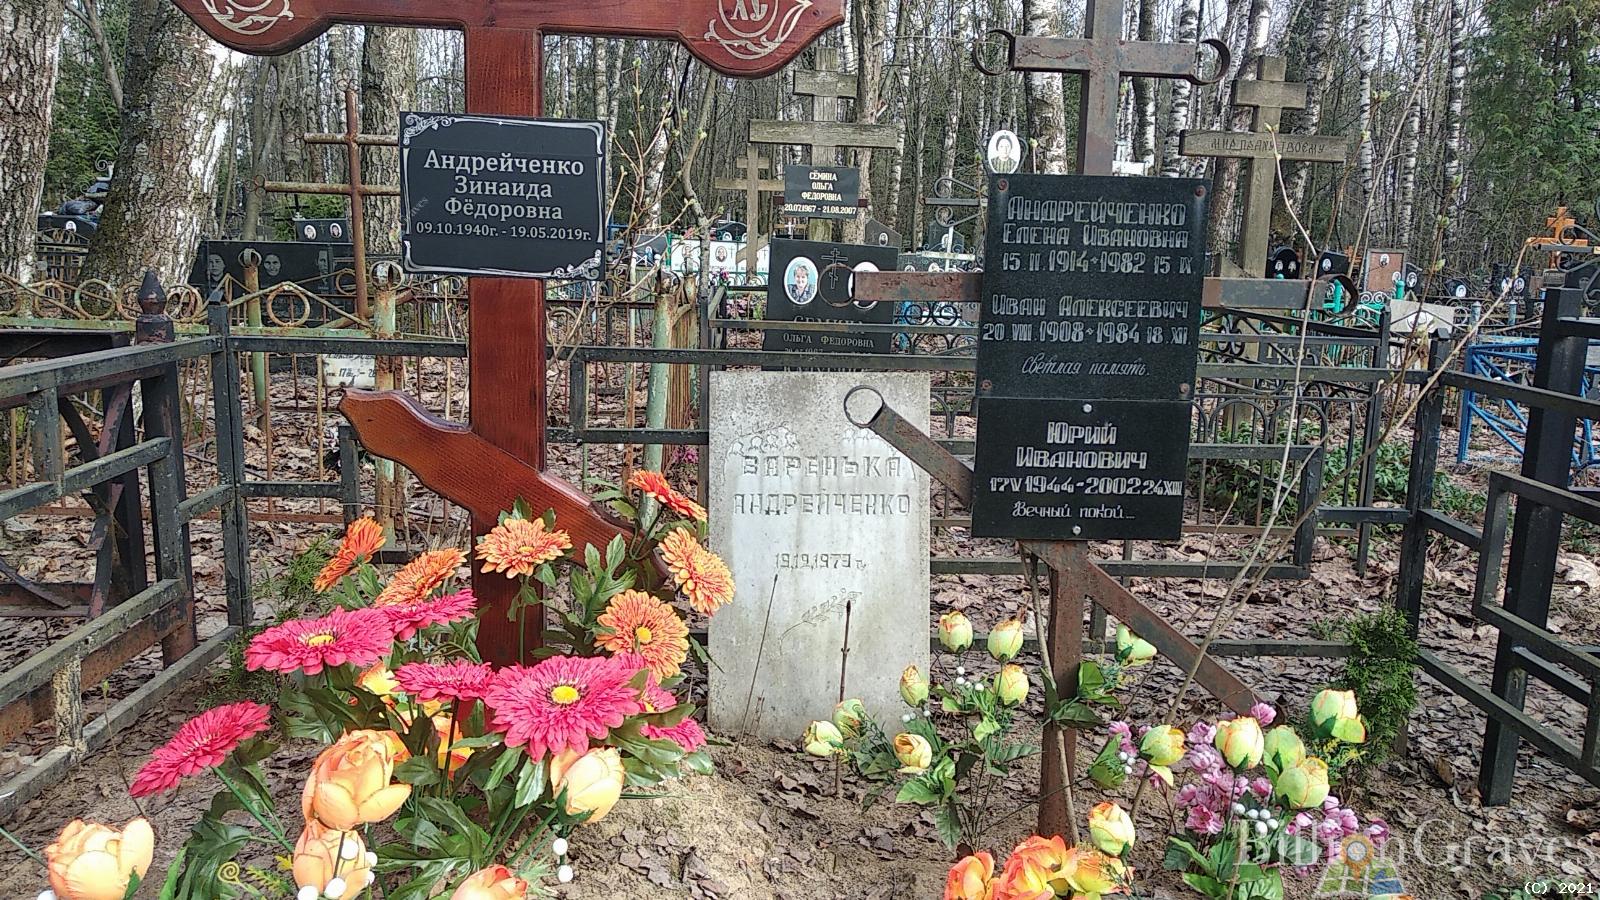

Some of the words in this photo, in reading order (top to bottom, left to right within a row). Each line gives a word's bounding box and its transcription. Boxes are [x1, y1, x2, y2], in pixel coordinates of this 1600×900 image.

[424, 150, 584, 176] Андрейченко
[454, 175, 552, 200] Зинаида
[811, 181, 834, 191] ОЛЬГА
[444, 197, 563, 222] Фёдоровна
[1007, 195, 1187, 226] АНДРЕЙЧЕНКО
[416, 222, 498, 236] 09.10.1940г.
[510, 226, 592, 241] 19.05.2019г.
[1083, 225, 1189, 249] ИВАНОВНА
[992, 294, 1046, 317] ИВАН
[1058, 296, 1189, 319] АЛЕКСЕЕВИЧ
[783, 332, 812, 344] ОЛЬГА
[820, 335, 874, 348] ФЕДОРОВНА
[1021, 352, 1081, 375] Светлая
[1047, 421, 1117, 445] ЮРИЙ
[743, 455, 901, 478] ВАРЕНЬКА
[1016, 446, 1148, 470] ИВАНОВИЧ
[733, 488, 911, 516] АНДРЕЙЧЕНКО
[1012, 500, 1072, 519] Вечный
